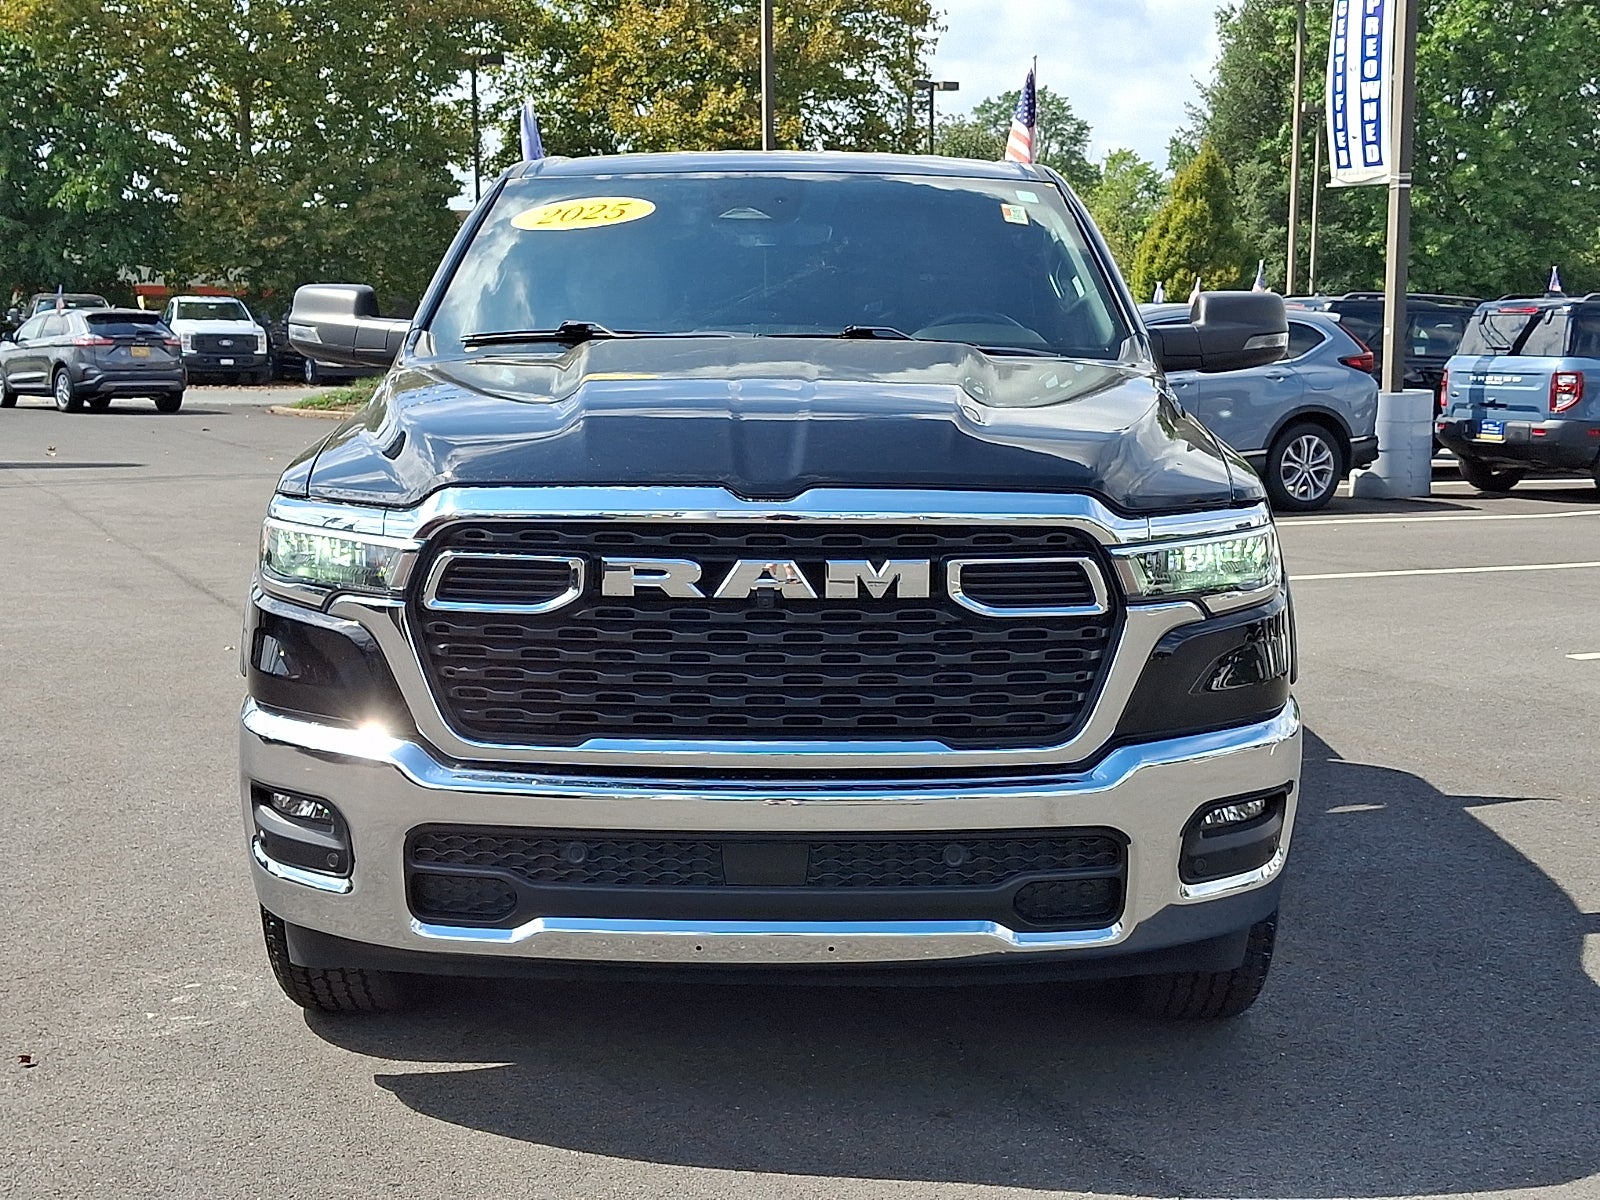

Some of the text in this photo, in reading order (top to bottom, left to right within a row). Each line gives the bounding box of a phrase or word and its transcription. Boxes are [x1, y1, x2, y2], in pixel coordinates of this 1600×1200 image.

[1361, 0, 1382, 164] PREOWNED
[536, 202, 632, 225] 2025
[601, 556, 932, 600] RAM
